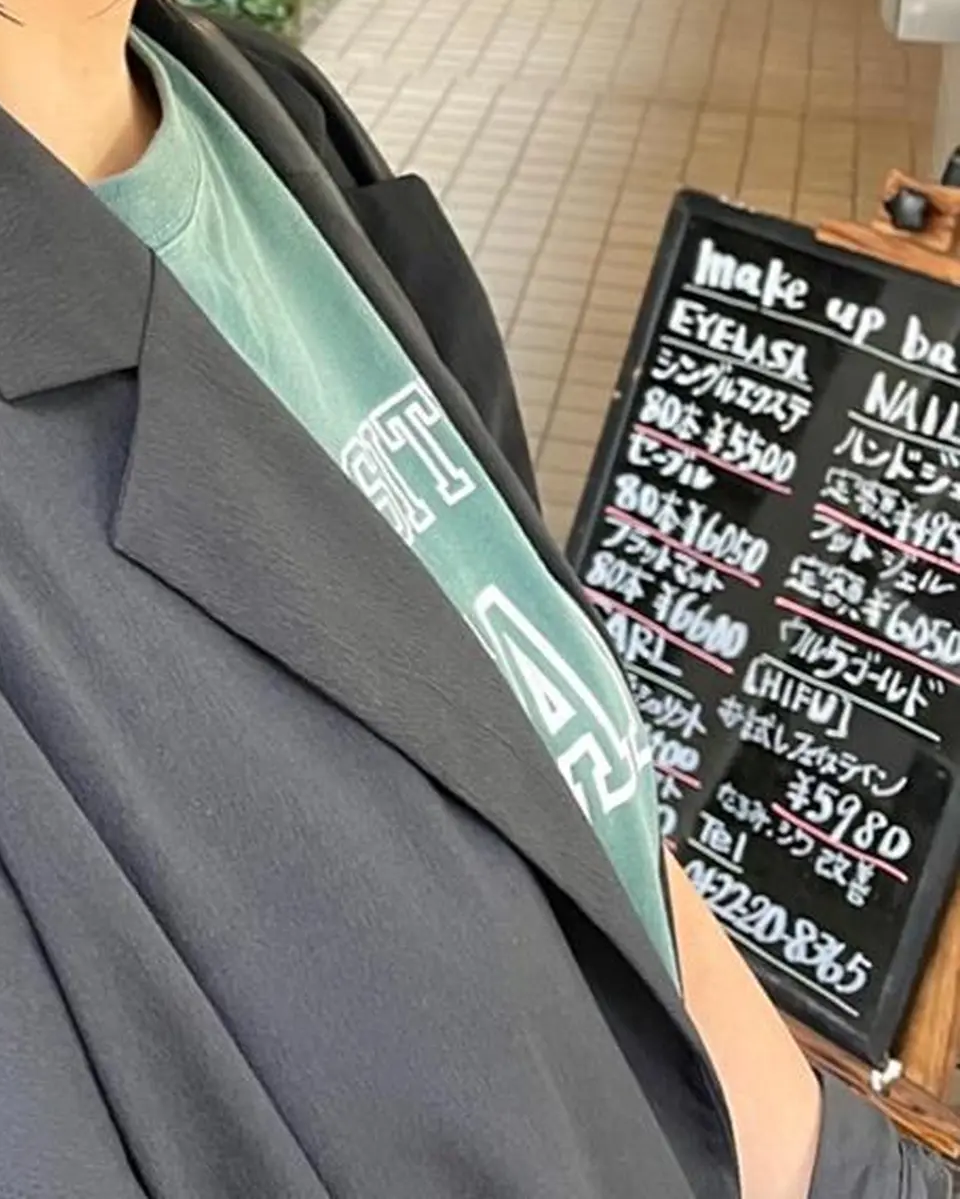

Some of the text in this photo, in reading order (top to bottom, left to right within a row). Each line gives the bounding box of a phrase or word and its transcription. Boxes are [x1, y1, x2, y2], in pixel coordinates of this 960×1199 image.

[693, 238, 809, 309] make
[825, 297, 886, 346] up
[651, 348, 812, 432] シングルエクステ
[699, 810, 747, 863] Tel
